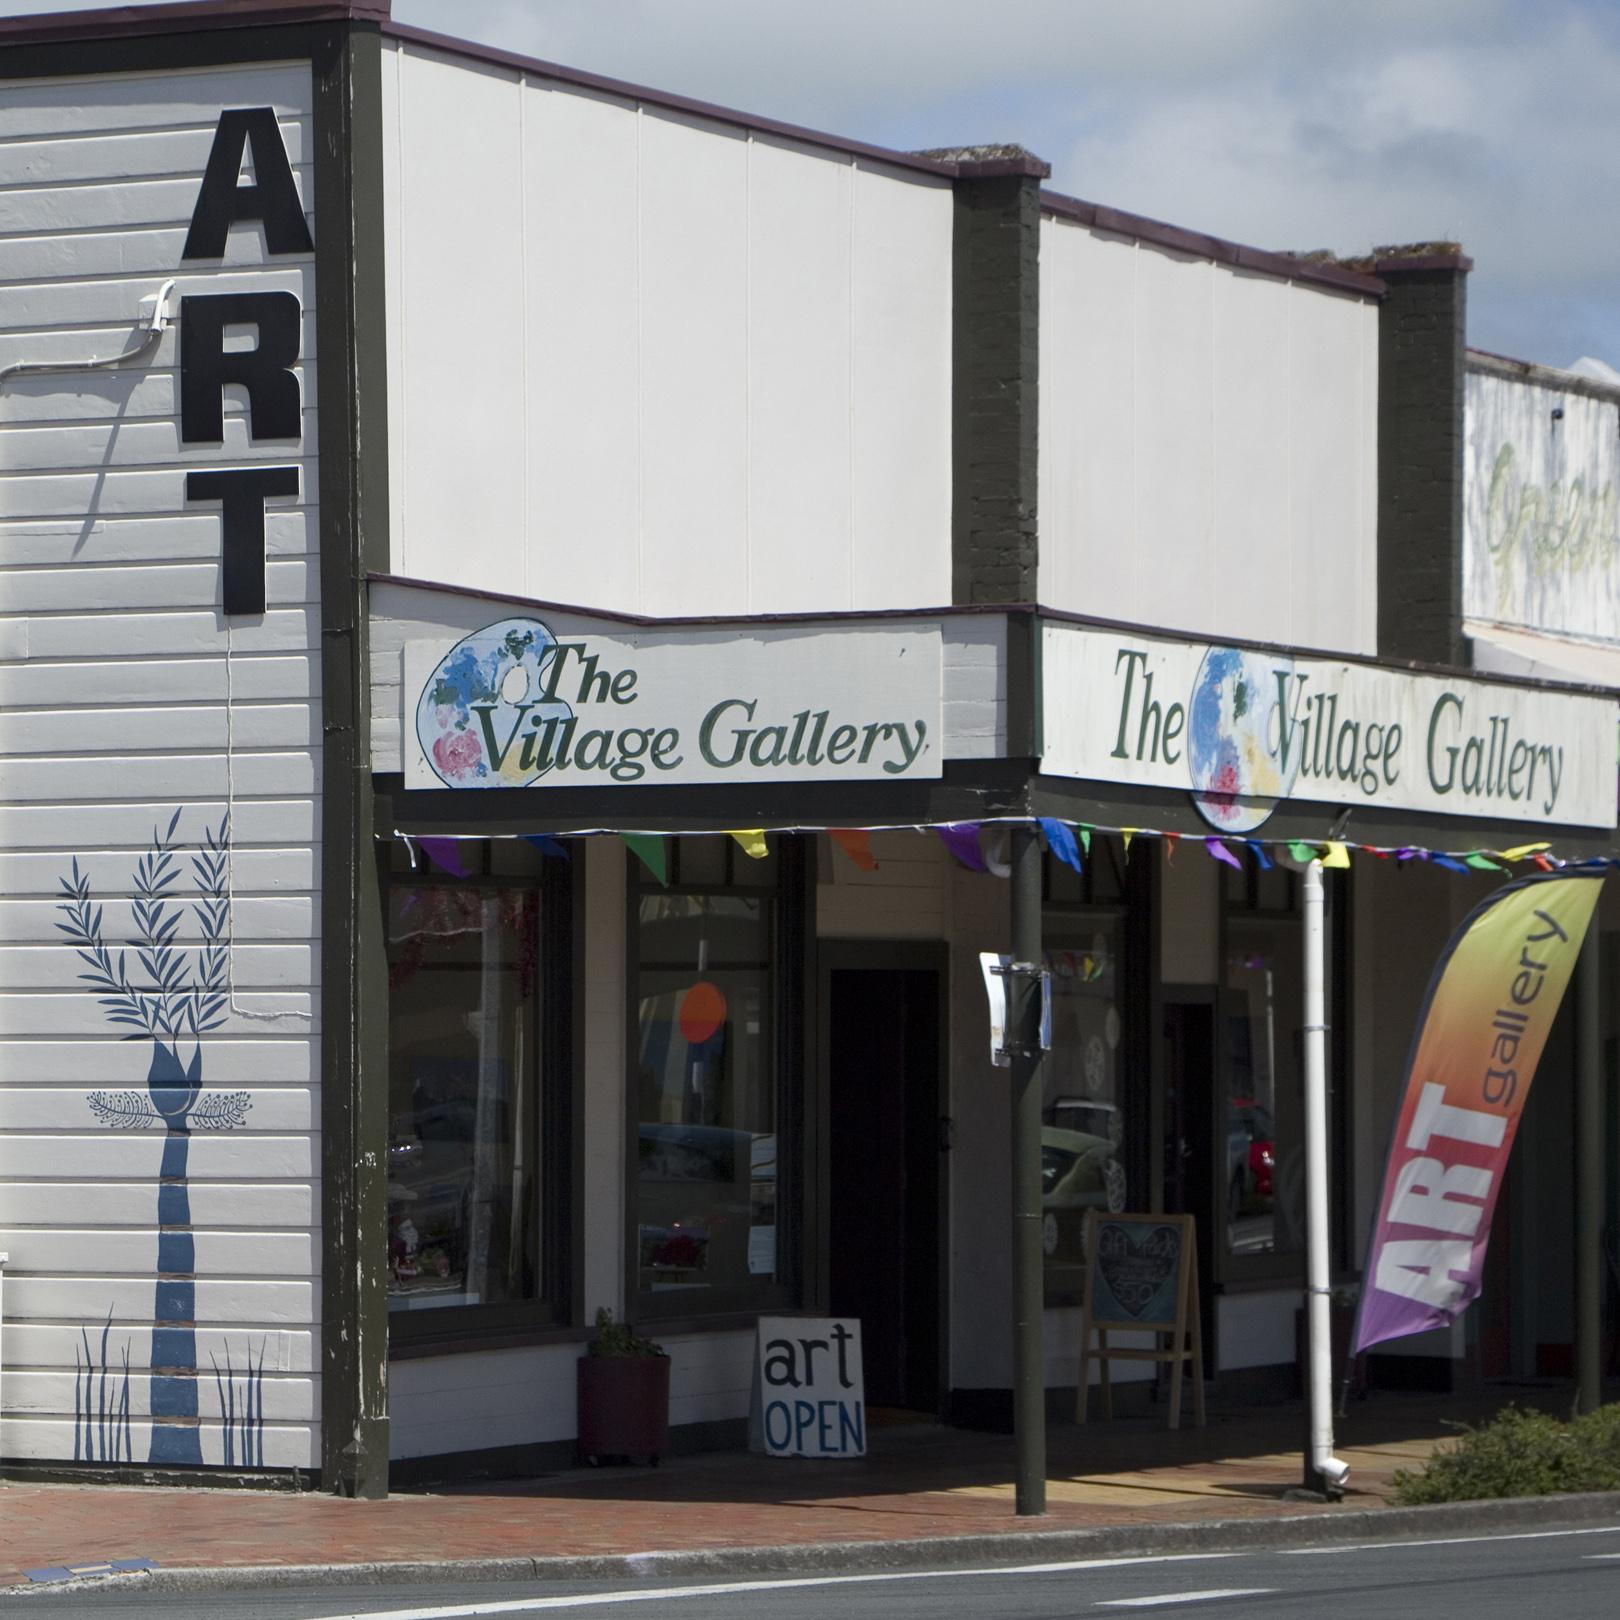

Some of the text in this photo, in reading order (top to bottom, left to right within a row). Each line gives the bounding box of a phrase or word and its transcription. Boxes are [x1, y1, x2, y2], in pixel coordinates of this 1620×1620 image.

[182, 106, 314, 614] ART
[534, 643, 638, 704] The
[471, 699, 927, 781] Village Gallery
[1111, 649, 1563, 815] The Village Gallery
[1375, 909, 1569, 1309] ART gallery
[764, 1323, 855, 1389] art
[765, 1400, 864, 1453] OPEN
